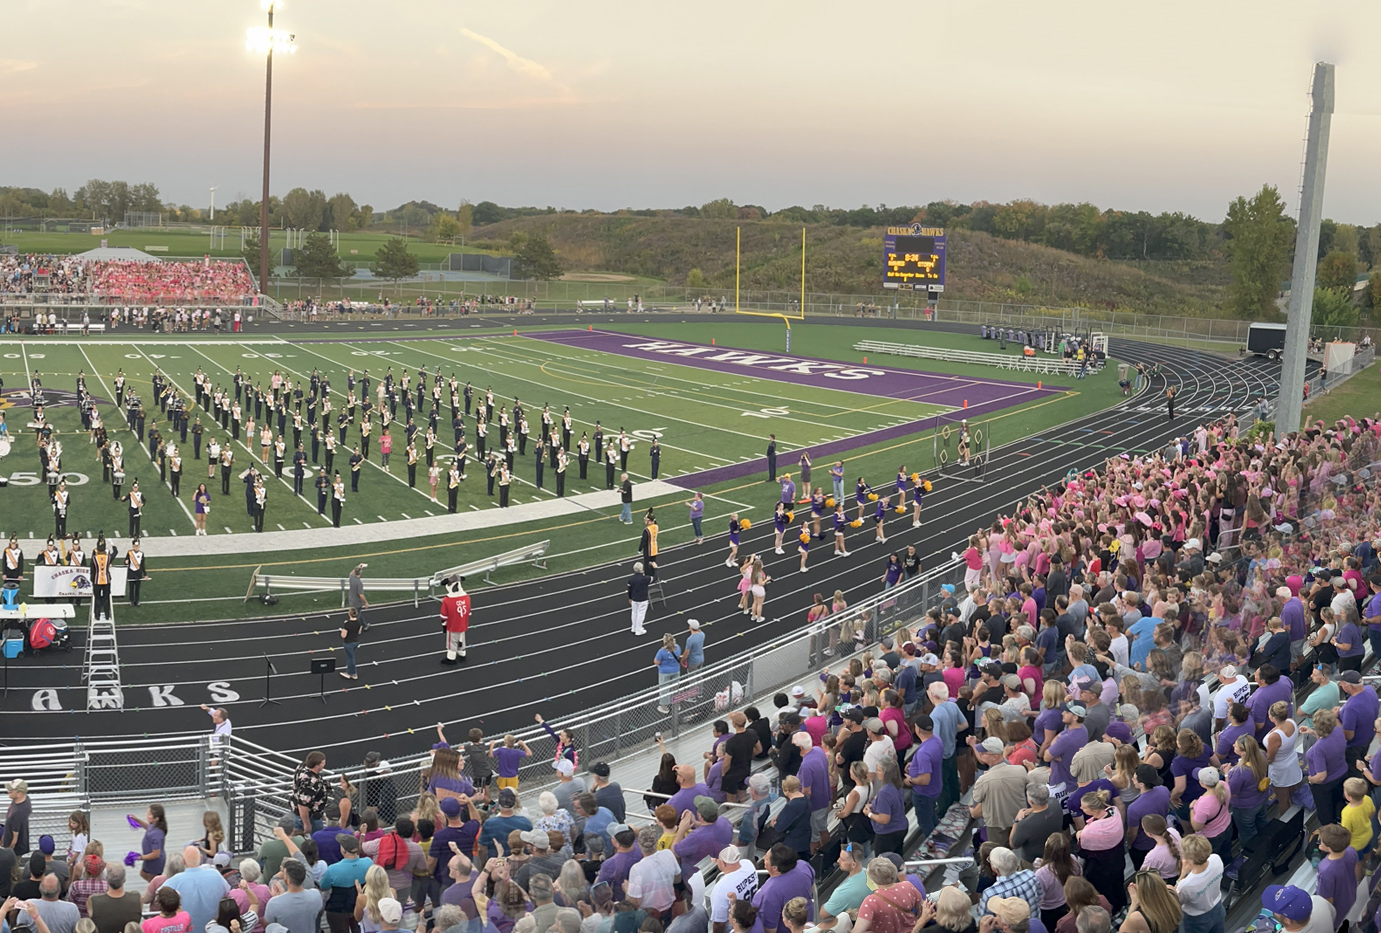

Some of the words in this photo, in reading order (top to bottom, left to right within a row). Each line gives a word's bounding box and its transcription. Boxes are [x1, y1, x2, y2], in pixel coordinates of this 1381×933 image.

[888, 226, 912, 236] CHASKA
[922, 228, 944, 236] HAWKS
[622, 341, 885, 380] HAWKS
[8, 472, 90, 486] 50
[51, 569, 74, 580] CHASKA
[457, 605, 467, 618] 95
